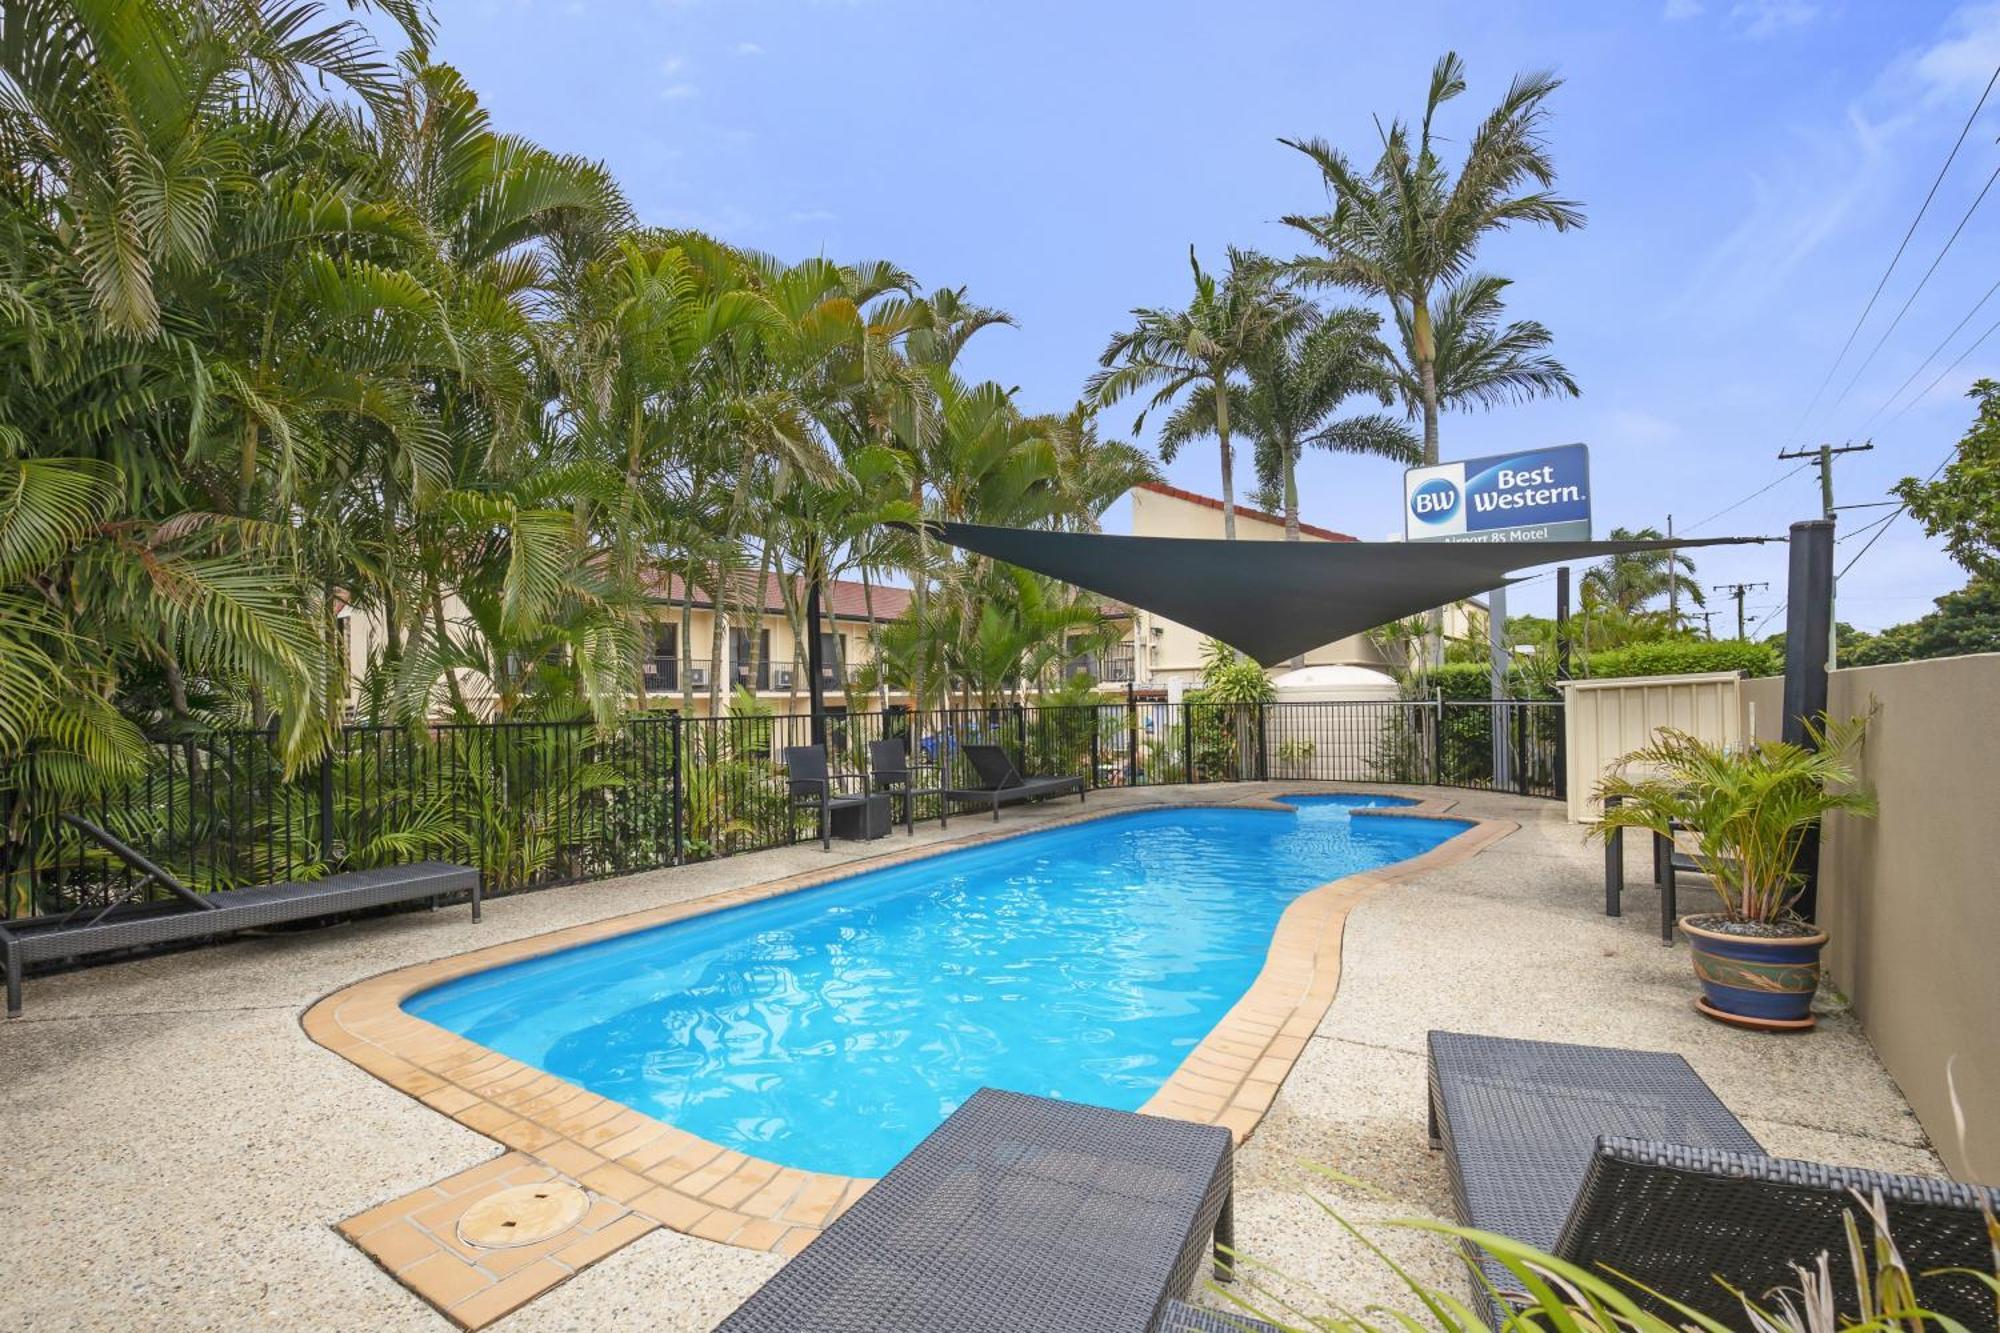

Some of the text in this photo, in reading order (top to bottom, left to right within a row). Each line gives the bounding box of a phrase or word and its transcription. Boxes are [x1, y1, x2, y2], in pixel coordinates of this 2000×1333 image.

[1498, 465, 1554, 490] Best
[1416, 489, 1455, 513] BW
[1474, 485, 1579, 513] Western
[1510, 527, 1549, 542] Motel
